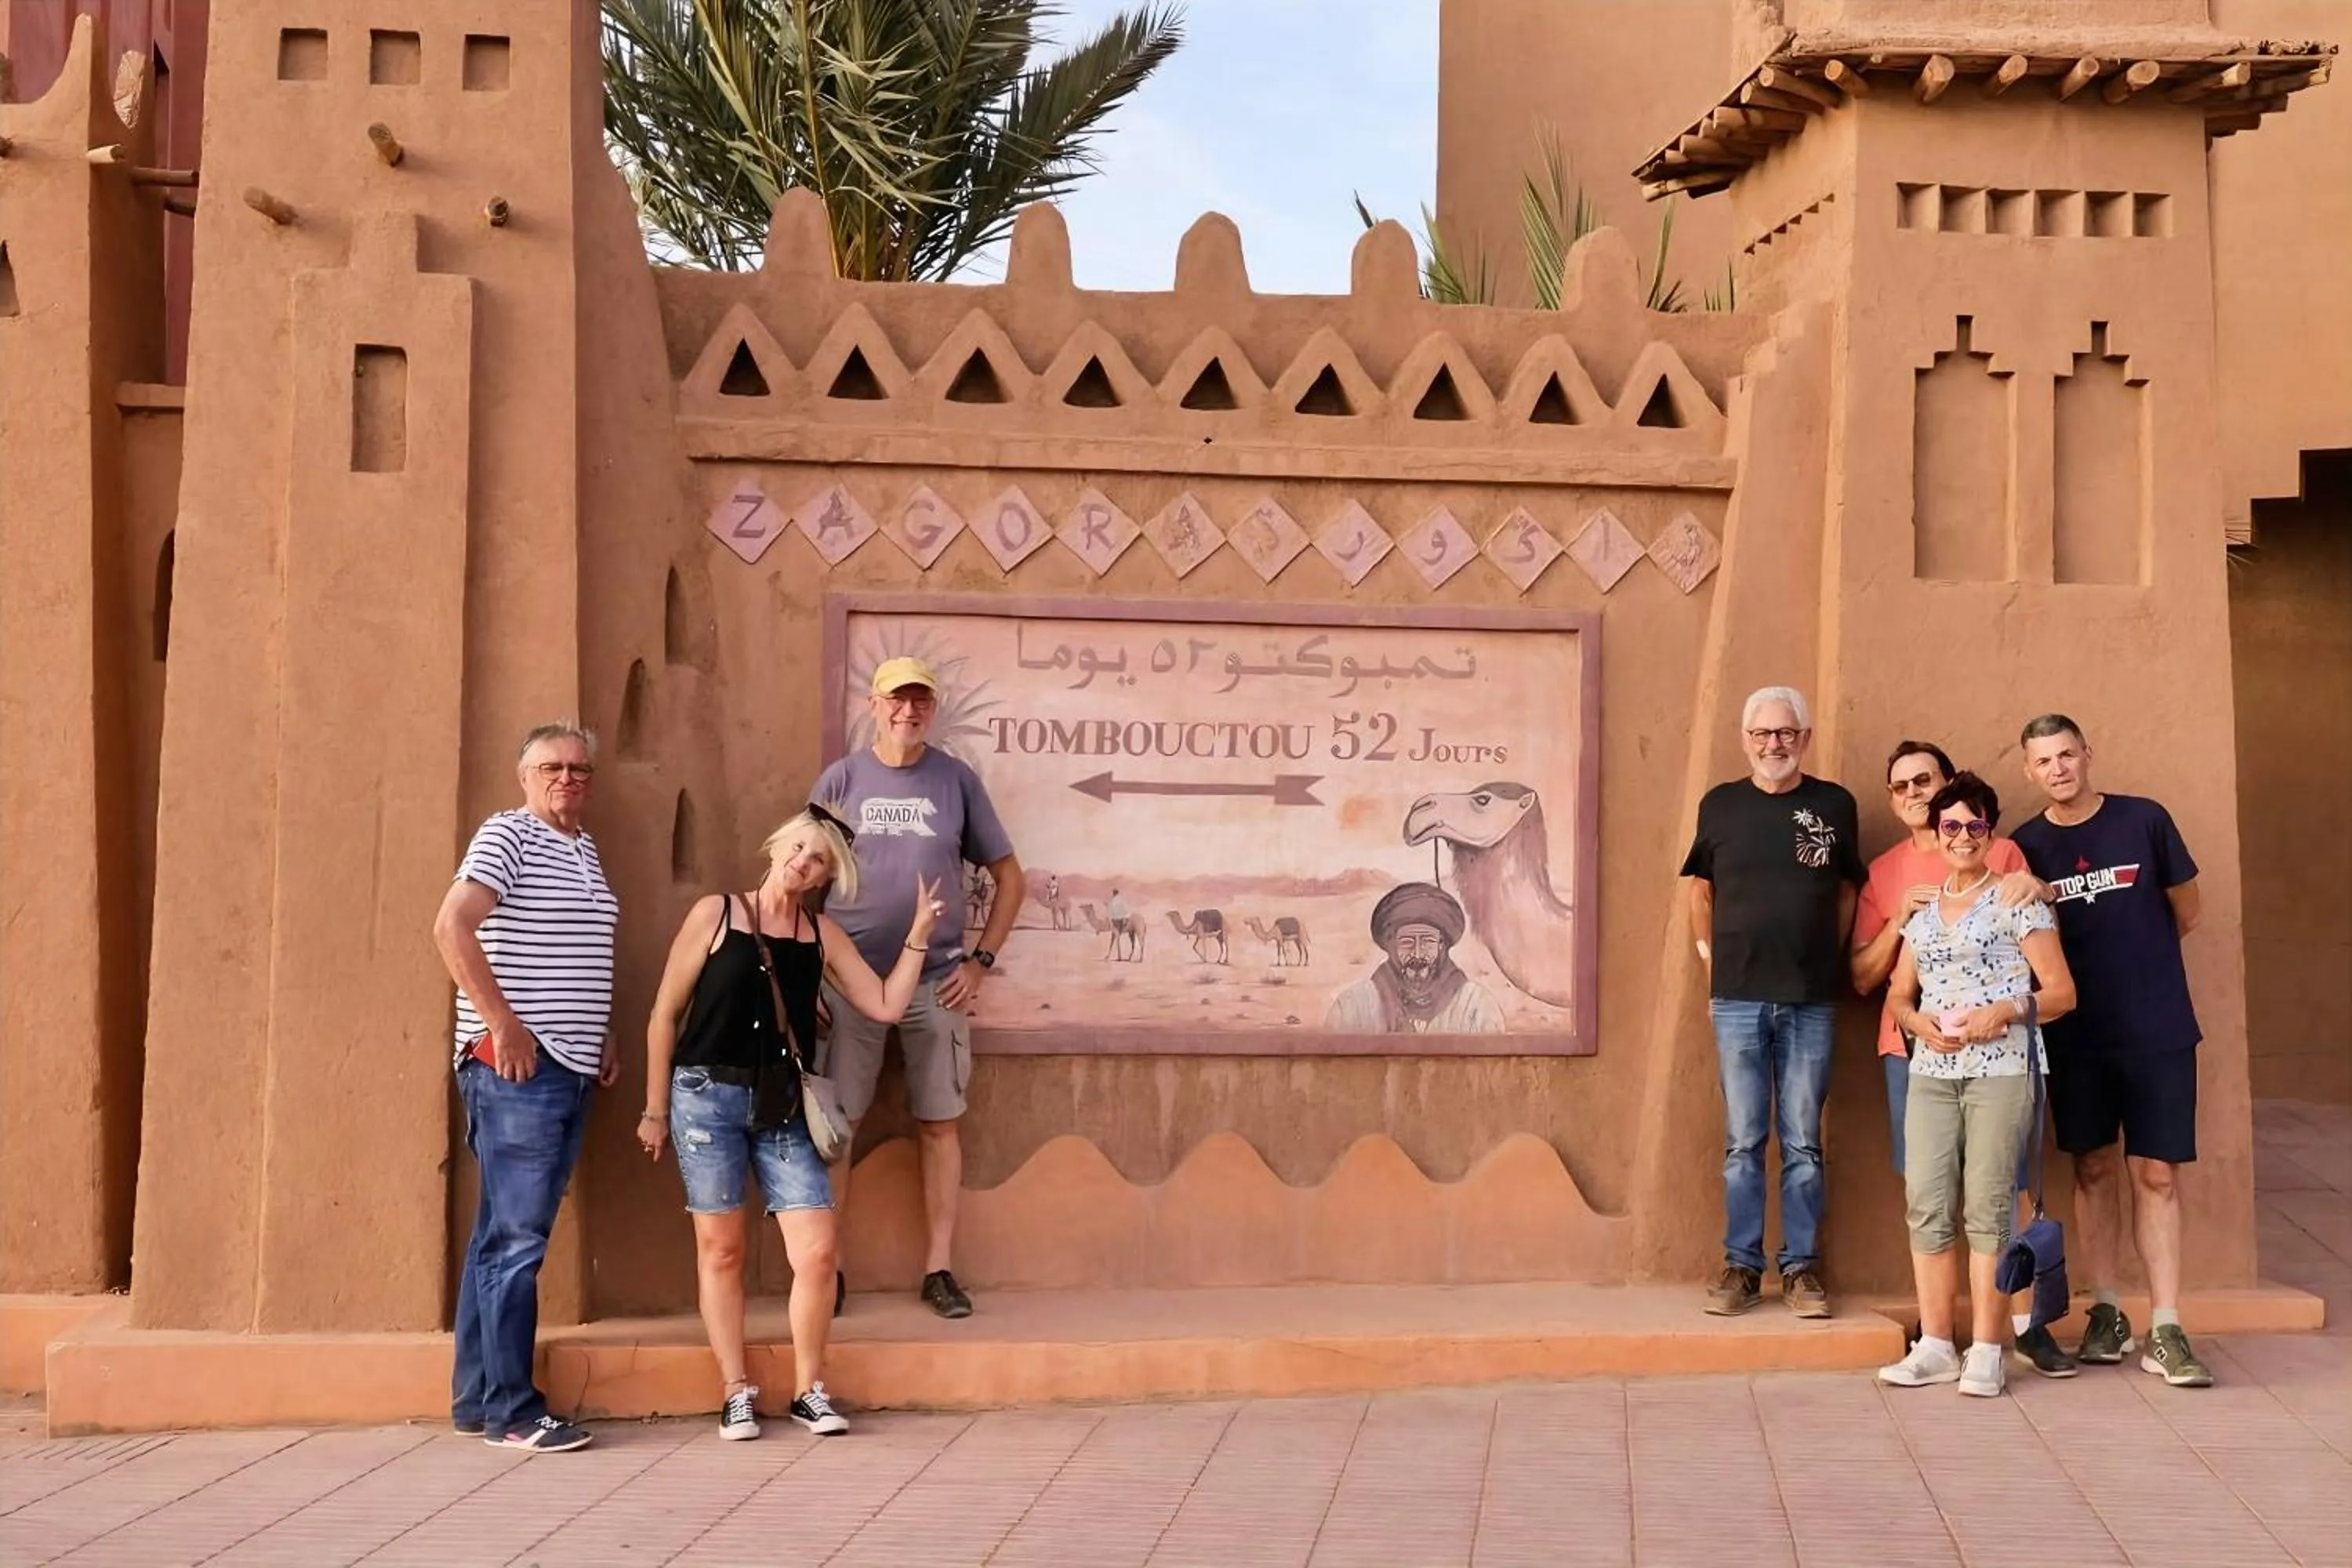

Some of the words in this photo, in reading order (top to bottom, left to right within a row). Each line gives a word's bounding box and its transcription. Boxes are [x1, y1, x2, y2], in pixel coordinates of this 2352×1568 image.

[1017, 622, 1138, 690] يوما
[988, 715, 1316, 759] TOMBOUCTOU
[1330, 710, 1399, 763] 52
[865, 806, 920, 823] CANADA
[2059, 874, 2086, 896] TOP
[2086, 867, 2117, 890] GUN
